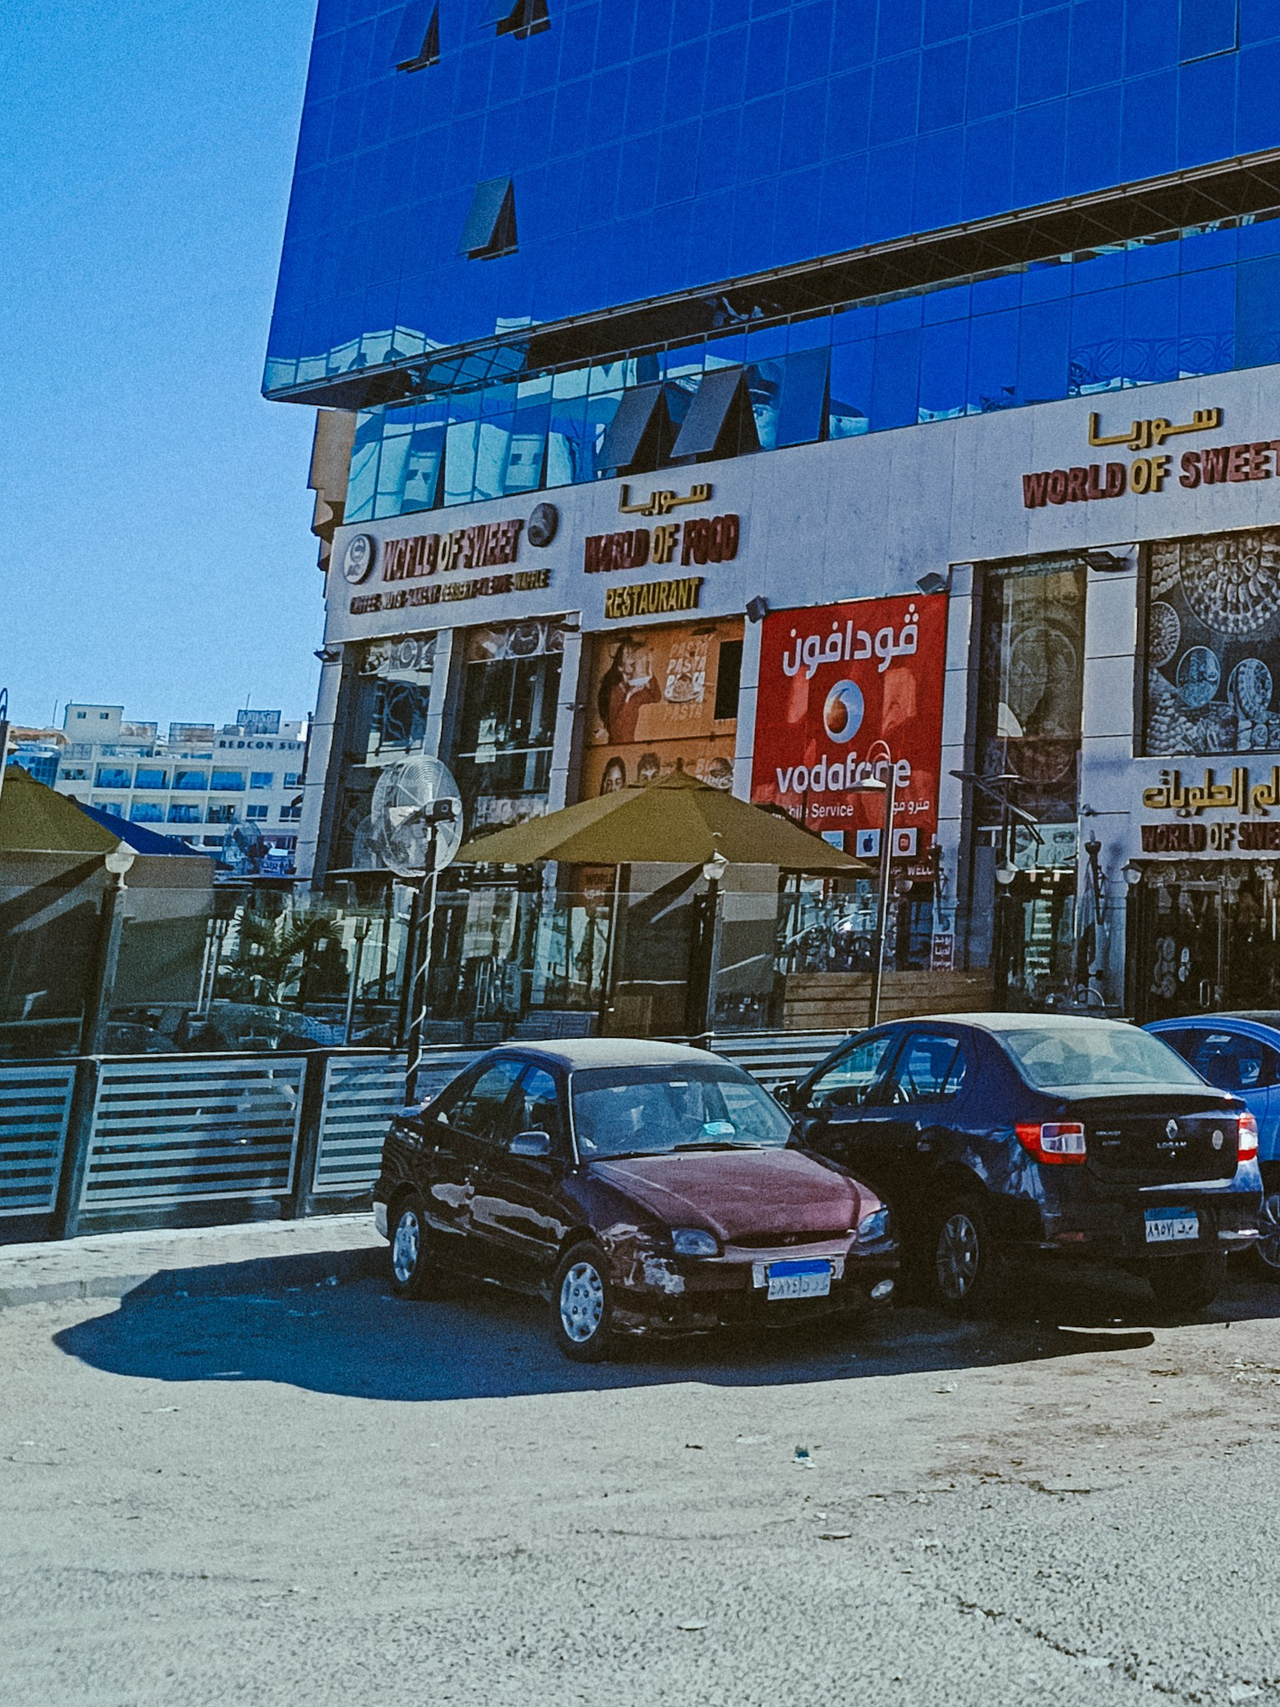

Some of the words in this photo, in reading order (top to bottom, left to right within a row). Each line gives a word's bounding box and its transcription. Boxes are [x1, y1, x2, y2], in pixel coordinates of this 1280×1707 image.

[1088, 407, 1224, 451] سوريا
[618, 482, 713, 517] سوريا
[1022, 461, 1126, 510] WORLD
[1129, 454, 1172, 495] OF
[382, 534, 440, 582] WORLD
[438, 530, 464, 572] OF
[463, 519, 526, 569] SWEET
[584, 528, 650, 573] WORLD
[650, 523, 680, 564] OF
[680, 513, 741, 567] FOOD
[604, 577, 704, 619] RESTAURANT
[666, 655, 707, 674] PASTA
[219, 740, 274, 750] REDCON
[811, 802, 854, 818] Service
[1143, 767, 1249, 818] الحلويات
[1141, 823, 1207, 853] WORLD
[1207, 822, 1237, 851] OF
